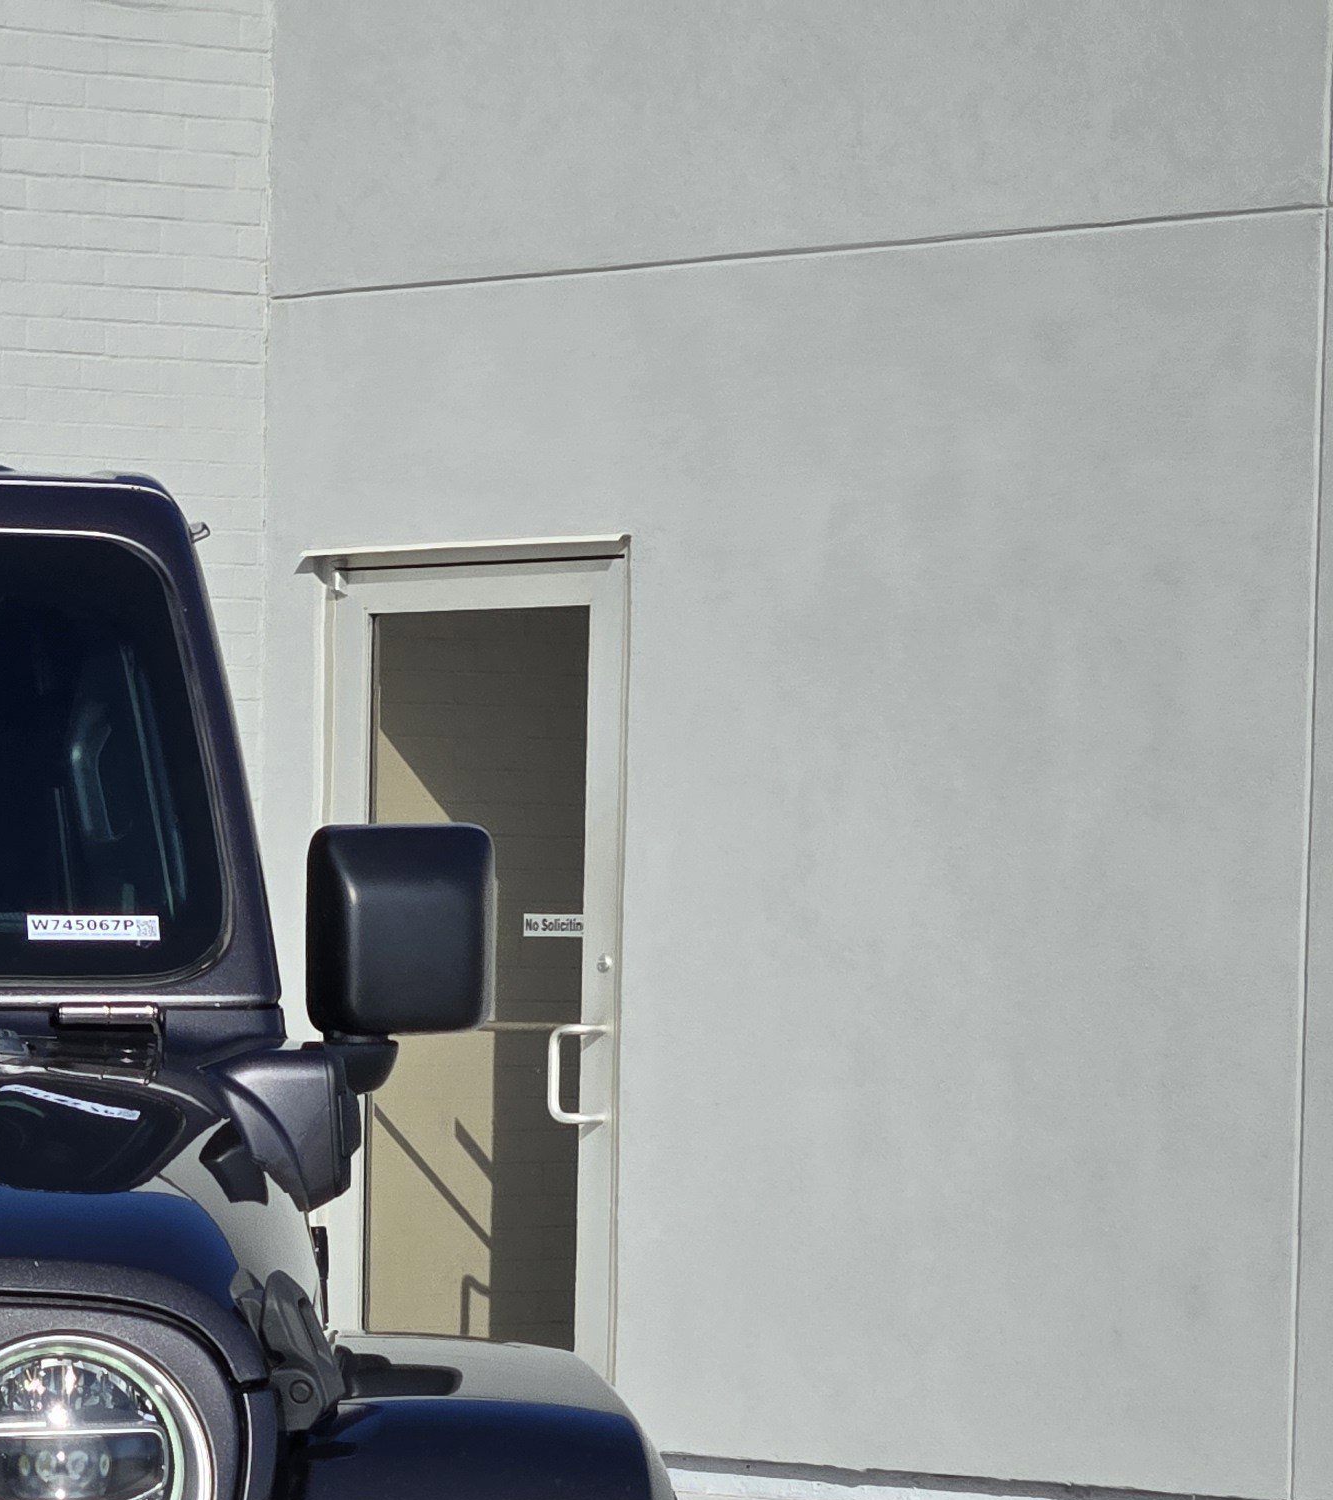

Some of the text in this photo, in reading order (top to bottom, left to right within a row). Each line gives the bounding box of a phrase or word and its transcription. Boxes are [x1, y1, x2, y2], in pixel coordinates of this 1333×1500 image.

[31, 919, 134, 931] W745067P
[525, 918, 583, 934] No Solicitin
